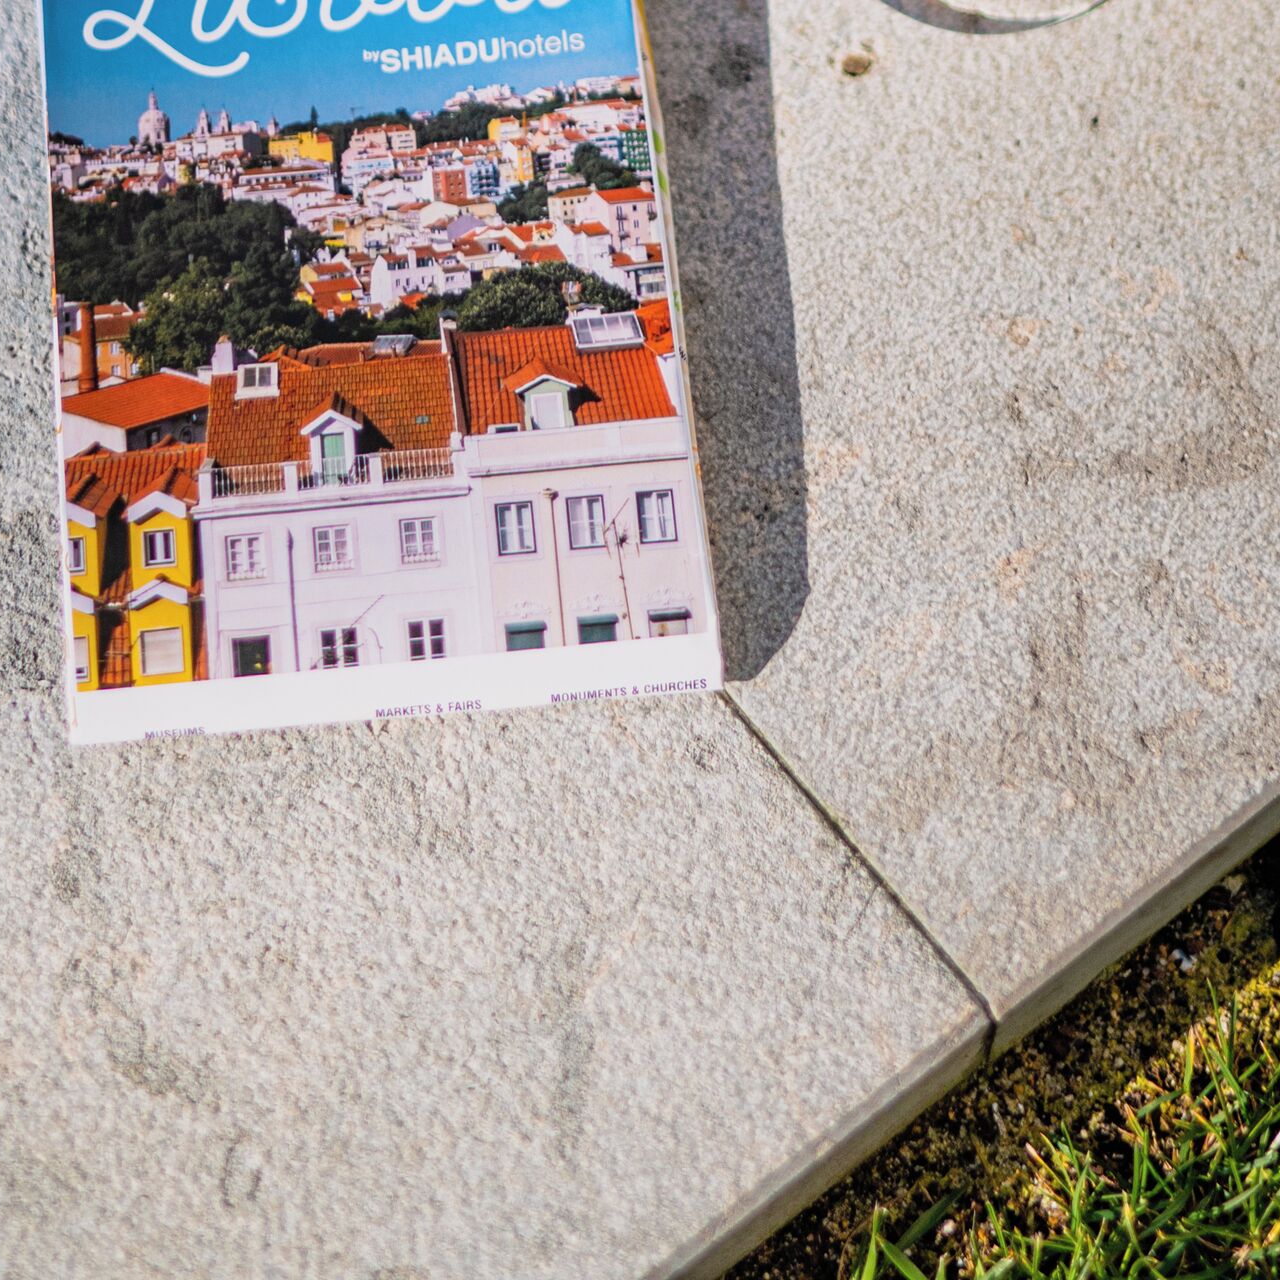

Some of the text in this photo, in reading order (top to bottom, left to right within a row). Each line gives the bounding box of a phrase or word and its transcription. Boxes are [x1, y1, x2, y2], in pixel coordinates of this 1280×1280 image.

[551, 678, 708, 704] MONUMENTS & CHURCHES
[375, 699, 483, 718] MARKETS & FAIRS
